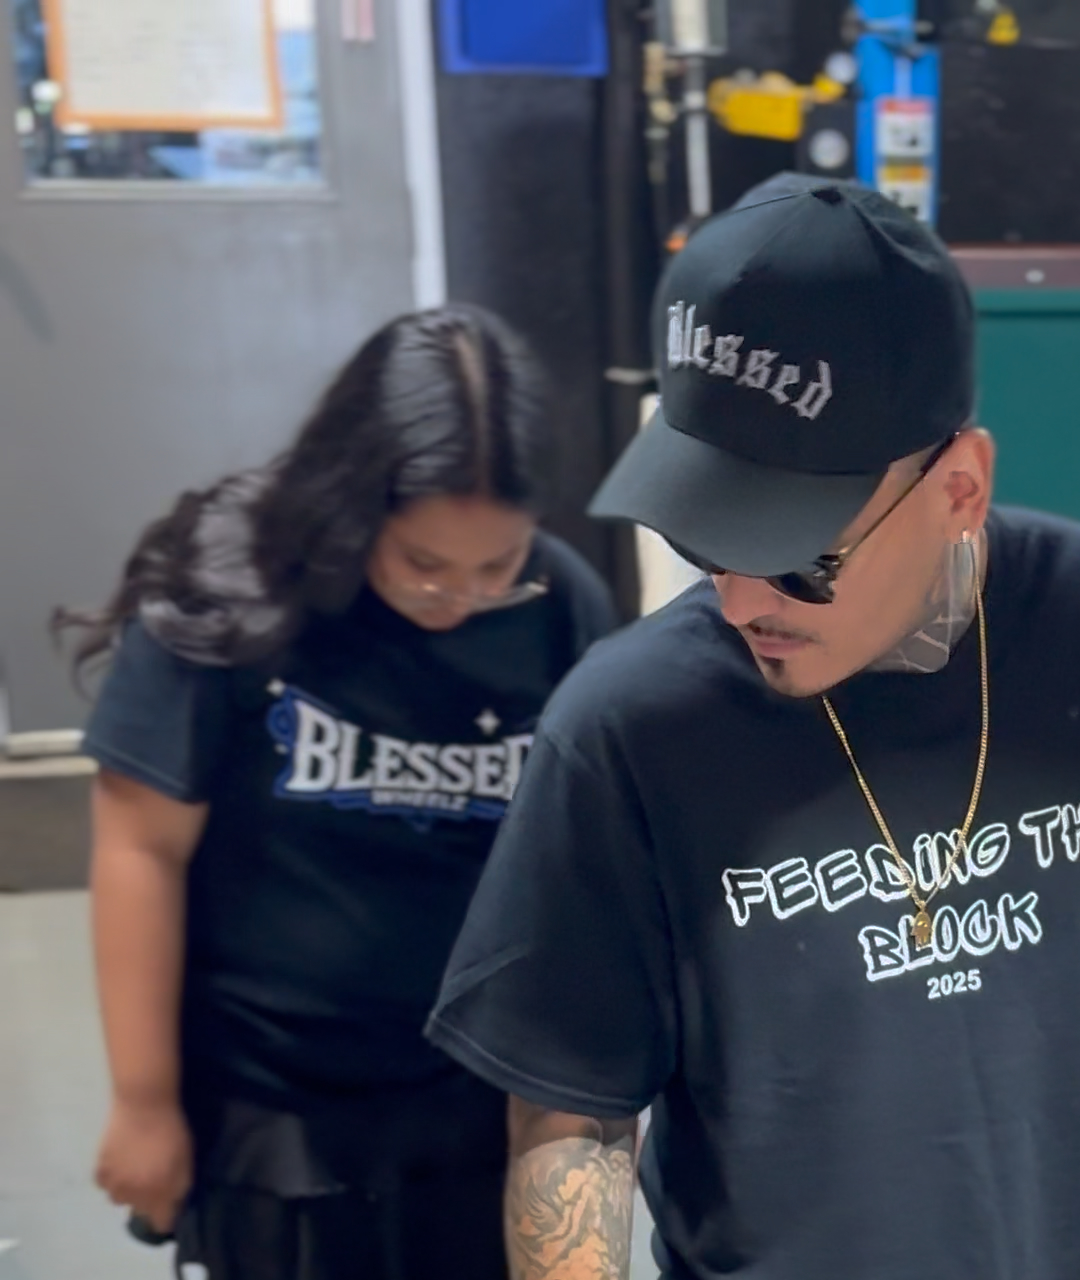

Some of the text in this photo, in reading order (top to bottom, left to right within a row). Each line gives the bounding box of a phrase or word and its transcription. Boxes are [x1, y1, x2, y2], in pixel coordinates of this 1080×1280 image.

[722, 823, 1012, 927] FEEDING
[857, 891, 1043, 982] BLOCK
[927, 968, 983, 1000] 2025
